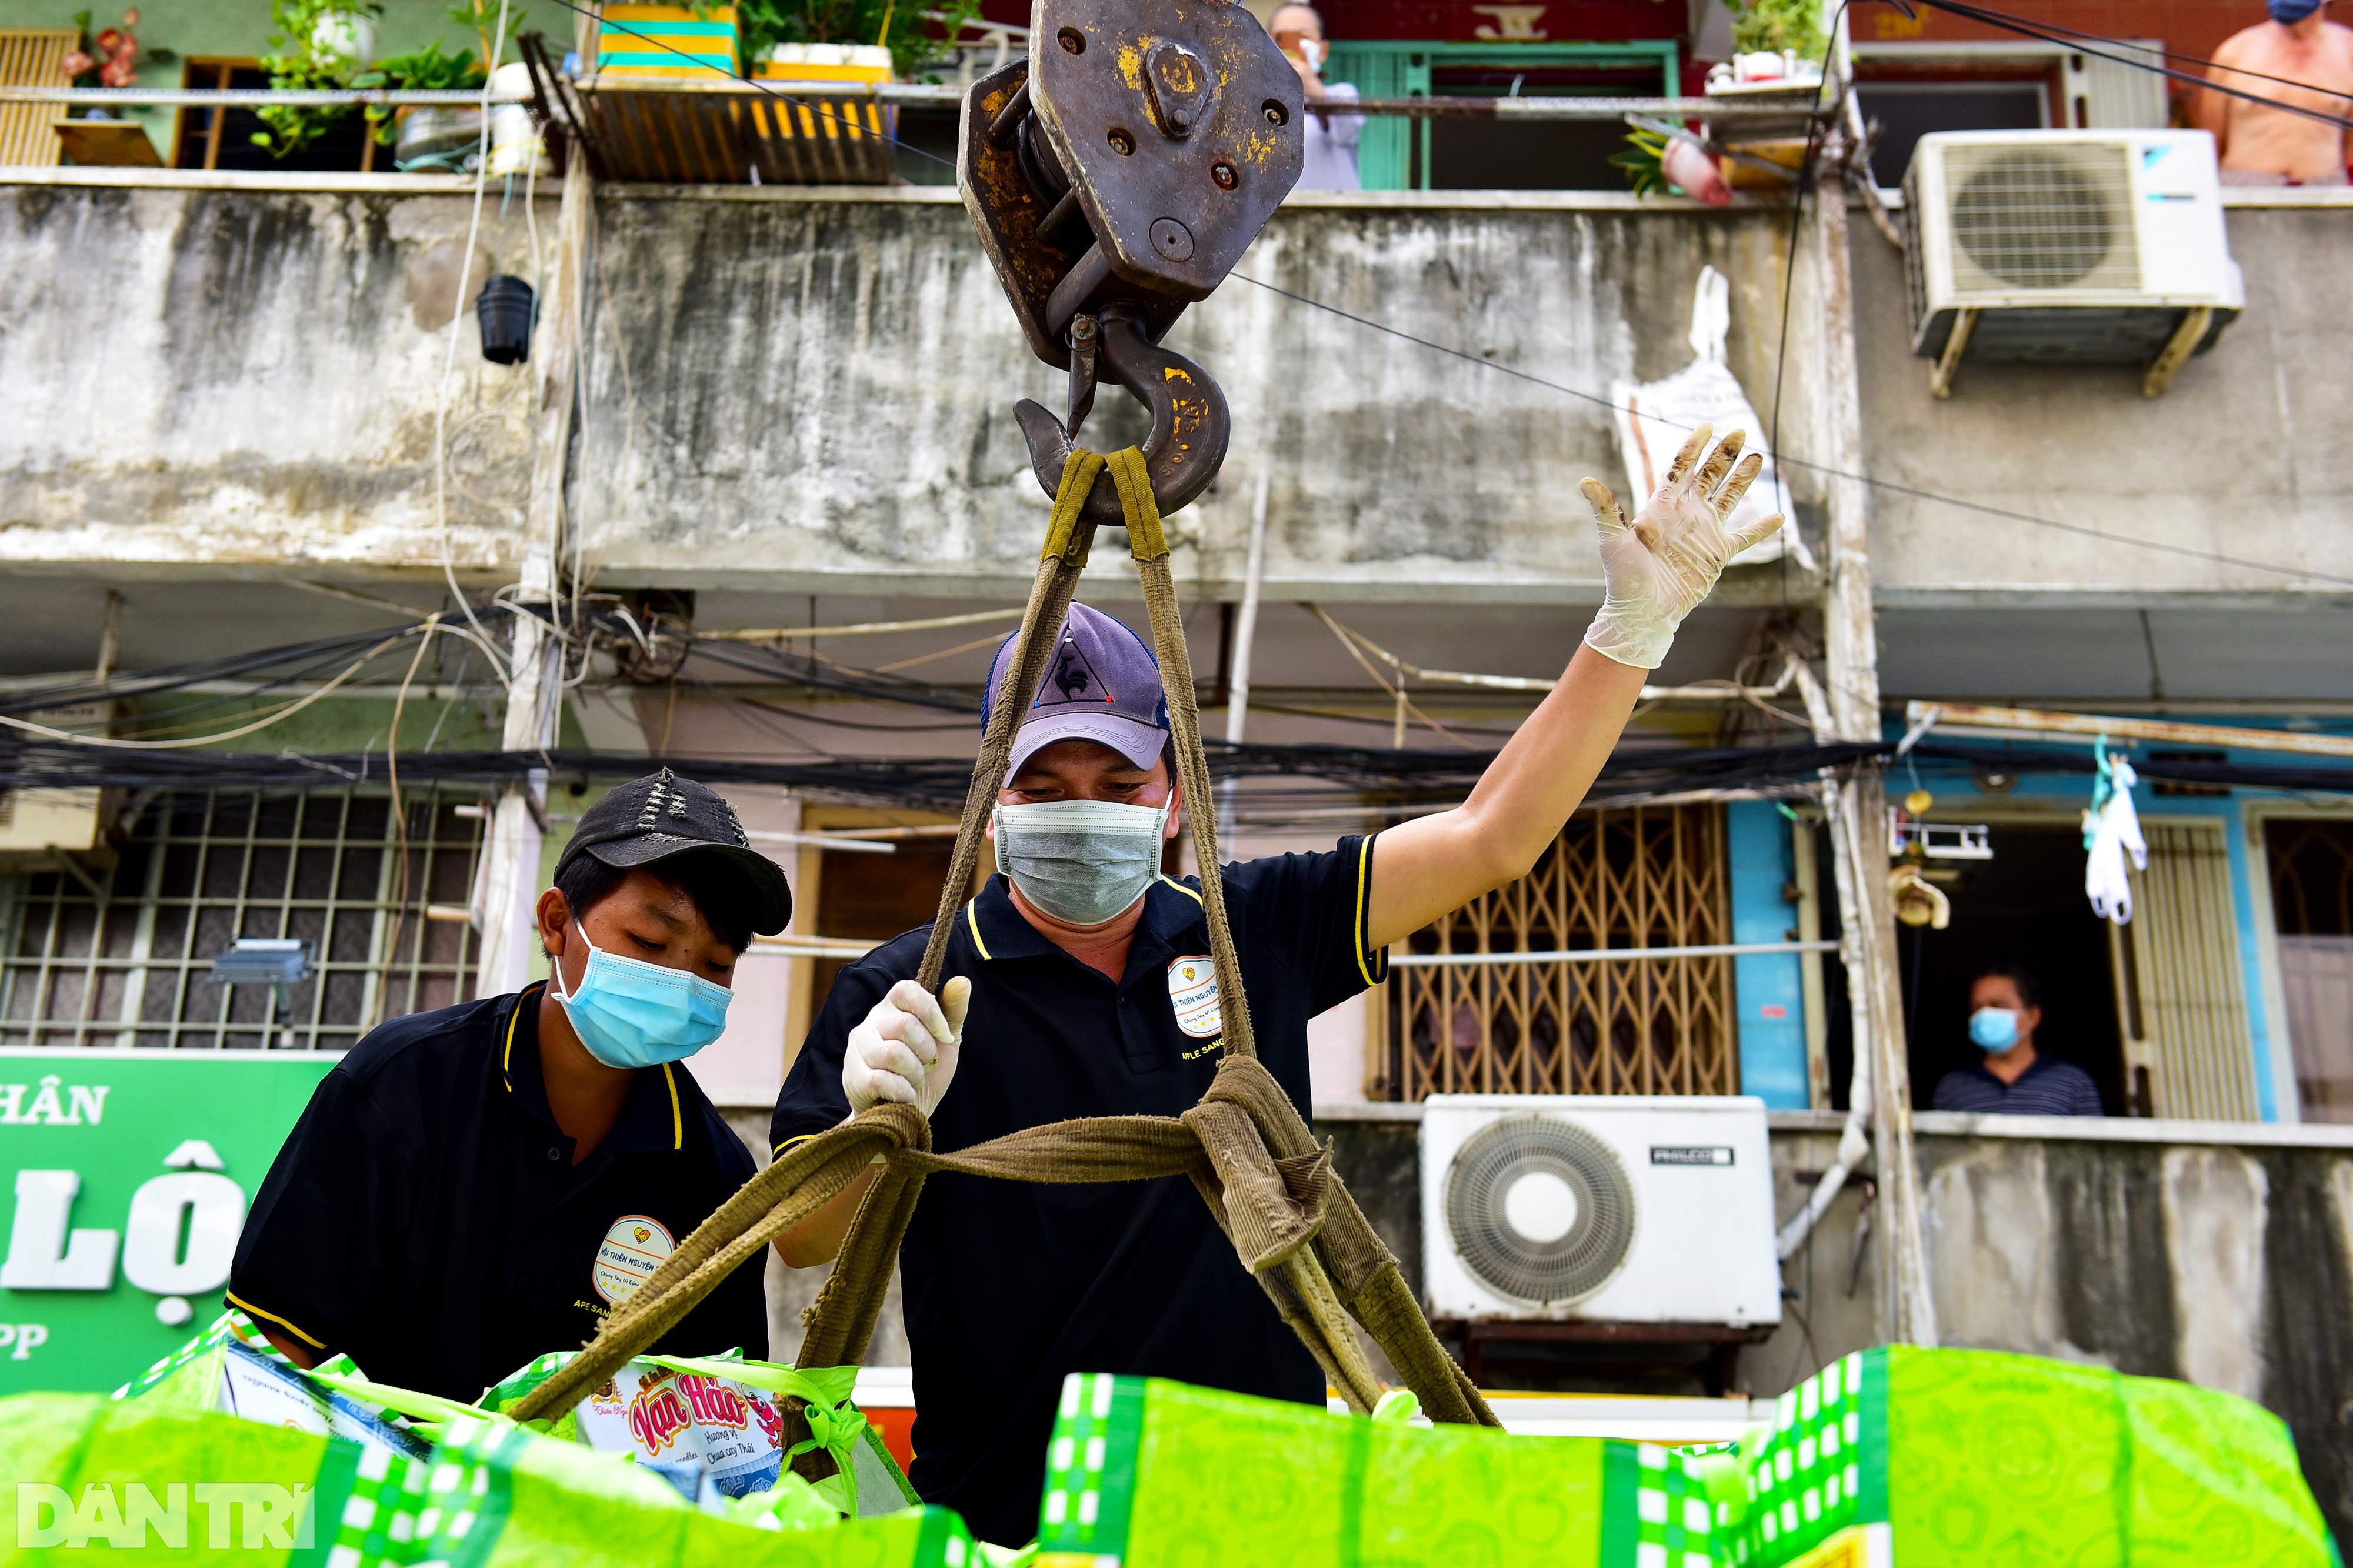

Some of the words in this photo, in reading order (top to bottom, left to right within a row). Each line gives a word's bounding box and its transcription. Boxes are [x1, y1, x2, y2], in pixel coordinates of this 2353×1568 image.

[1178, 996, 1195, 1006] THIỆN
[1195, 984, 1217, 1001] NGUYỆN
[601, 1247, 609, 1258] HỘI
[610, 1251, 628, 1263] THIỆN
[628, 1257, 654, 1272] NGUYỆN
[601, 1270, 613, 1280] Chung
[591, 1305, 610, 1318] SAN
[632, 1390, 688, 1452] Vạn
[704, 1429, 729, 1445] Hương
[729, 1428, 738, 1440] vị
[706, 1450, 725, 1464] Chua
[725, 1447, 738, 1457] cay
[737, 1443, 755, 1454] Thái
